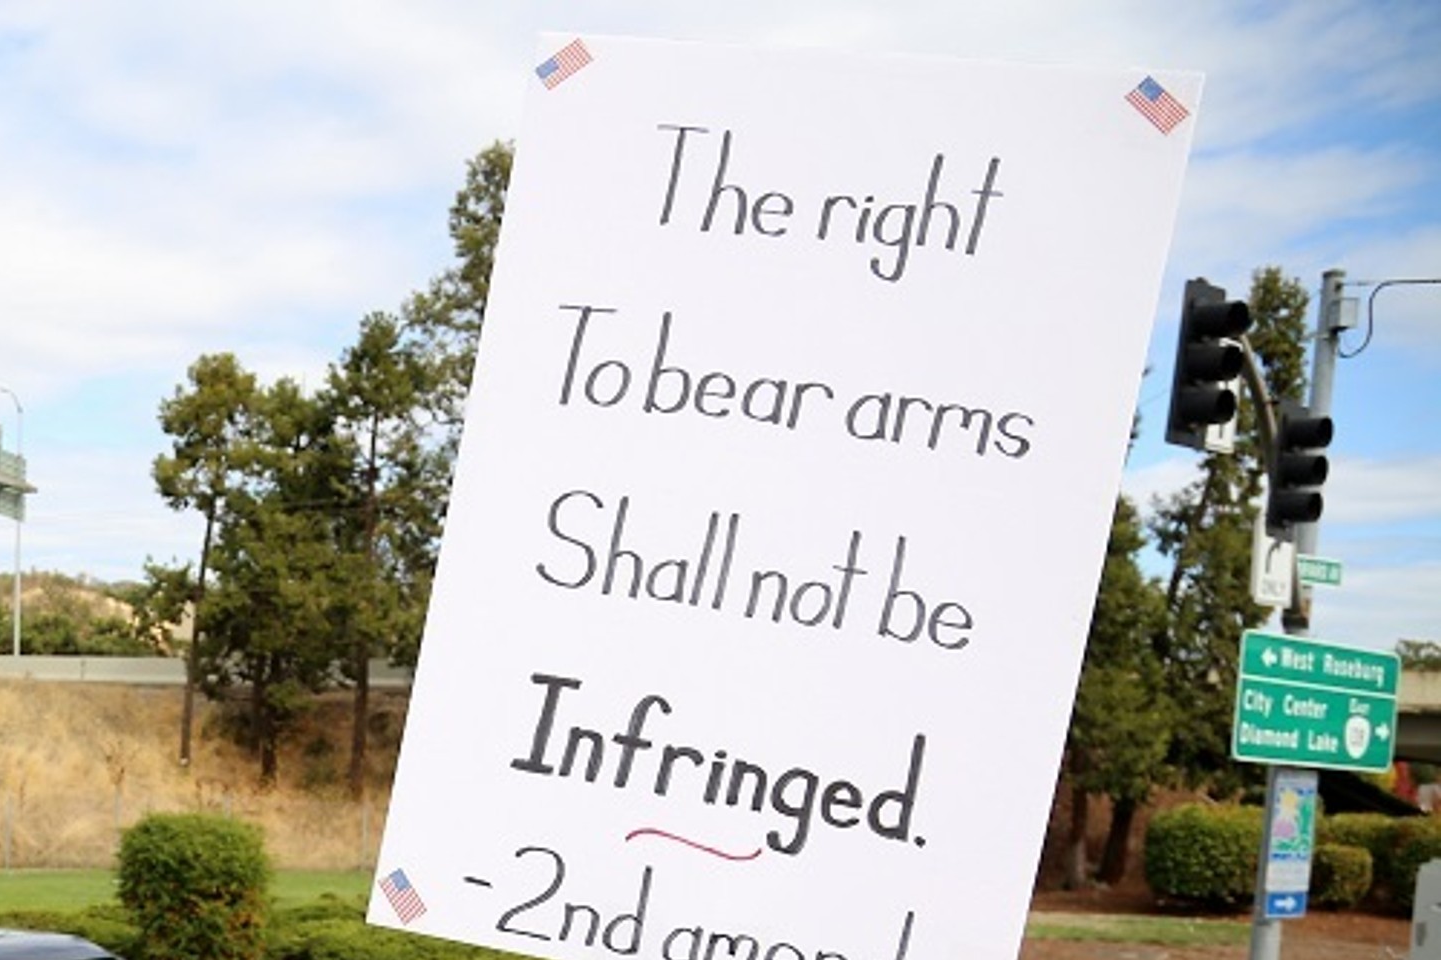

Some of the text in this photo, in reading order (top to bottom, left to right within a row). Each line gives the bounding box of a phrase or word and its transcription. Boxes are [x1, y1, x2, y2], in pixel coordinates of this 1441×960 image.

[658, 123, 1003, 283] The right
[559, 304, 1037, 460] To bear arms
[536, 489, 975, 651] Shall not be
[1239, 722, 1339, 753] Diamond Lake
[1243, 689, 1327, 719] City Center
[1281, 647, 1385, 688] West Roseburg
[508, 670, 928, 858] Infringed.
